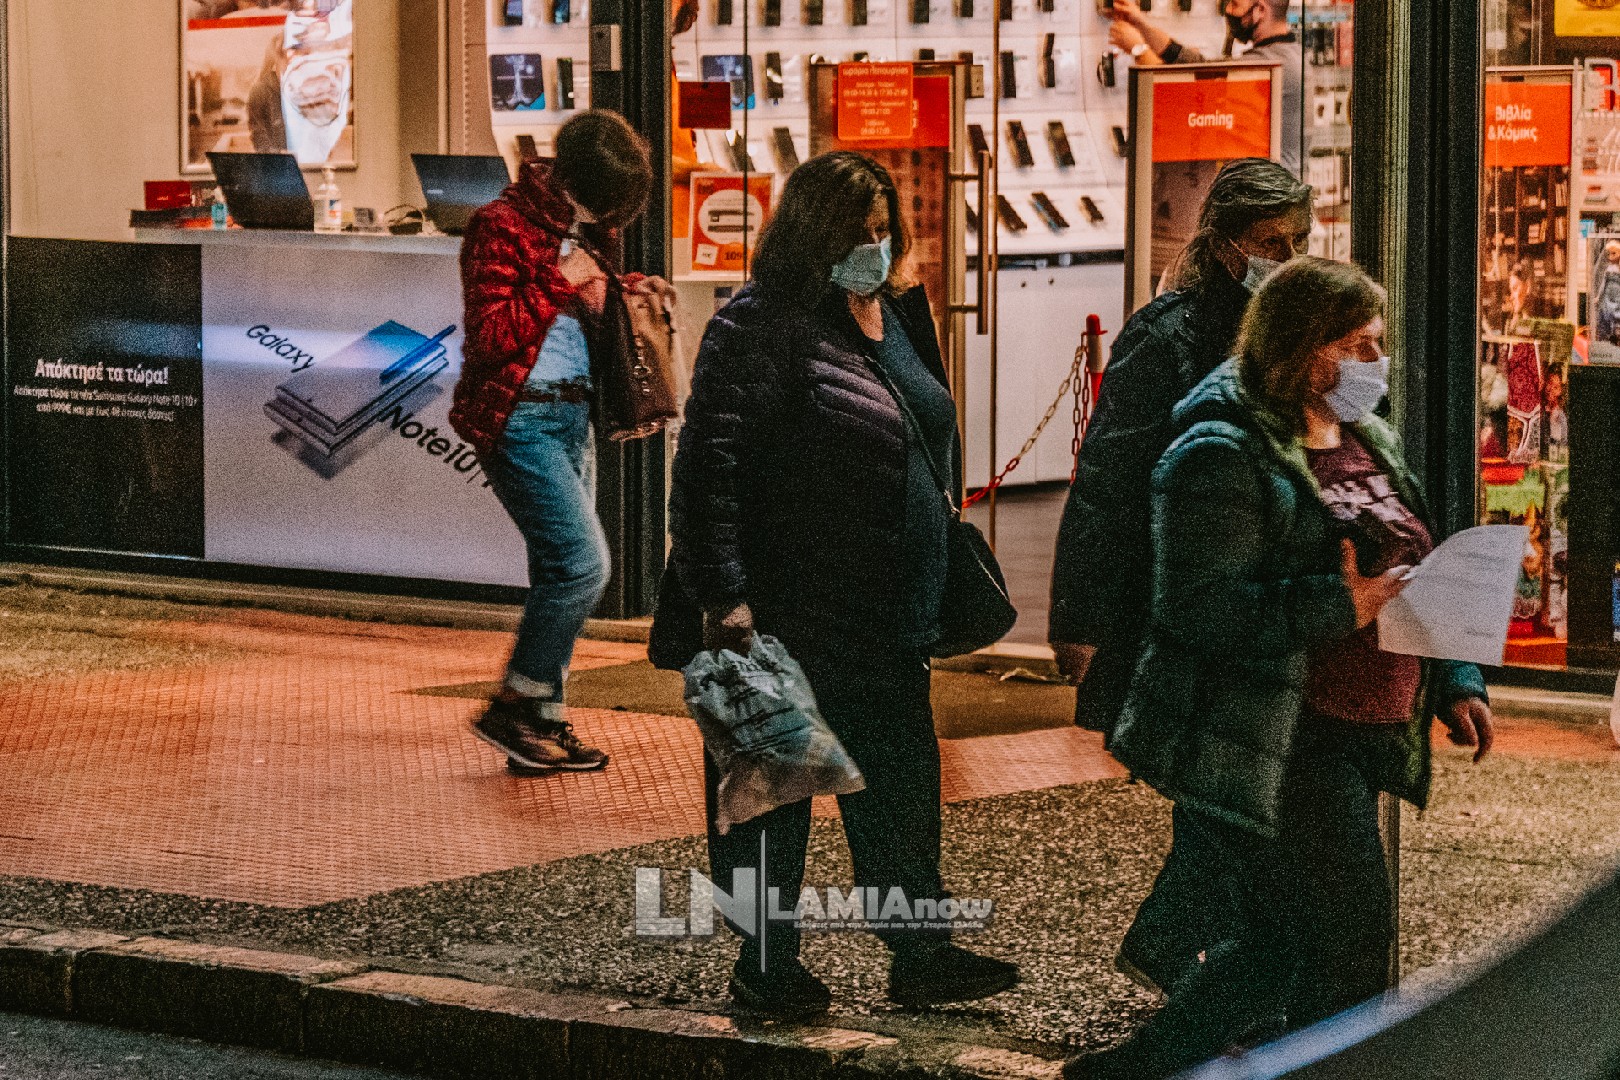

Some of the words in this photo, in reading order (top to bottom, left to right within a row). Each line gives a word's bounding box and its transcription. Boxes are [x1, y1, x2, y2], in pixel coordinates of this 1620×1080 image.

[1187, 109, 1234, 130] Gaming
[1495, 103, 1532, 123] Βιβλία
[1487, 124, 1496, 141] &
[1497, 122, 1537, 143] Κόμικς
[246, 324, 316, 374] Galaxy
[35, 358, 104, 385] Απόκτησέ
[106, 366, 124, 383] τα
[126, 363, 170, 388] τώρα!
